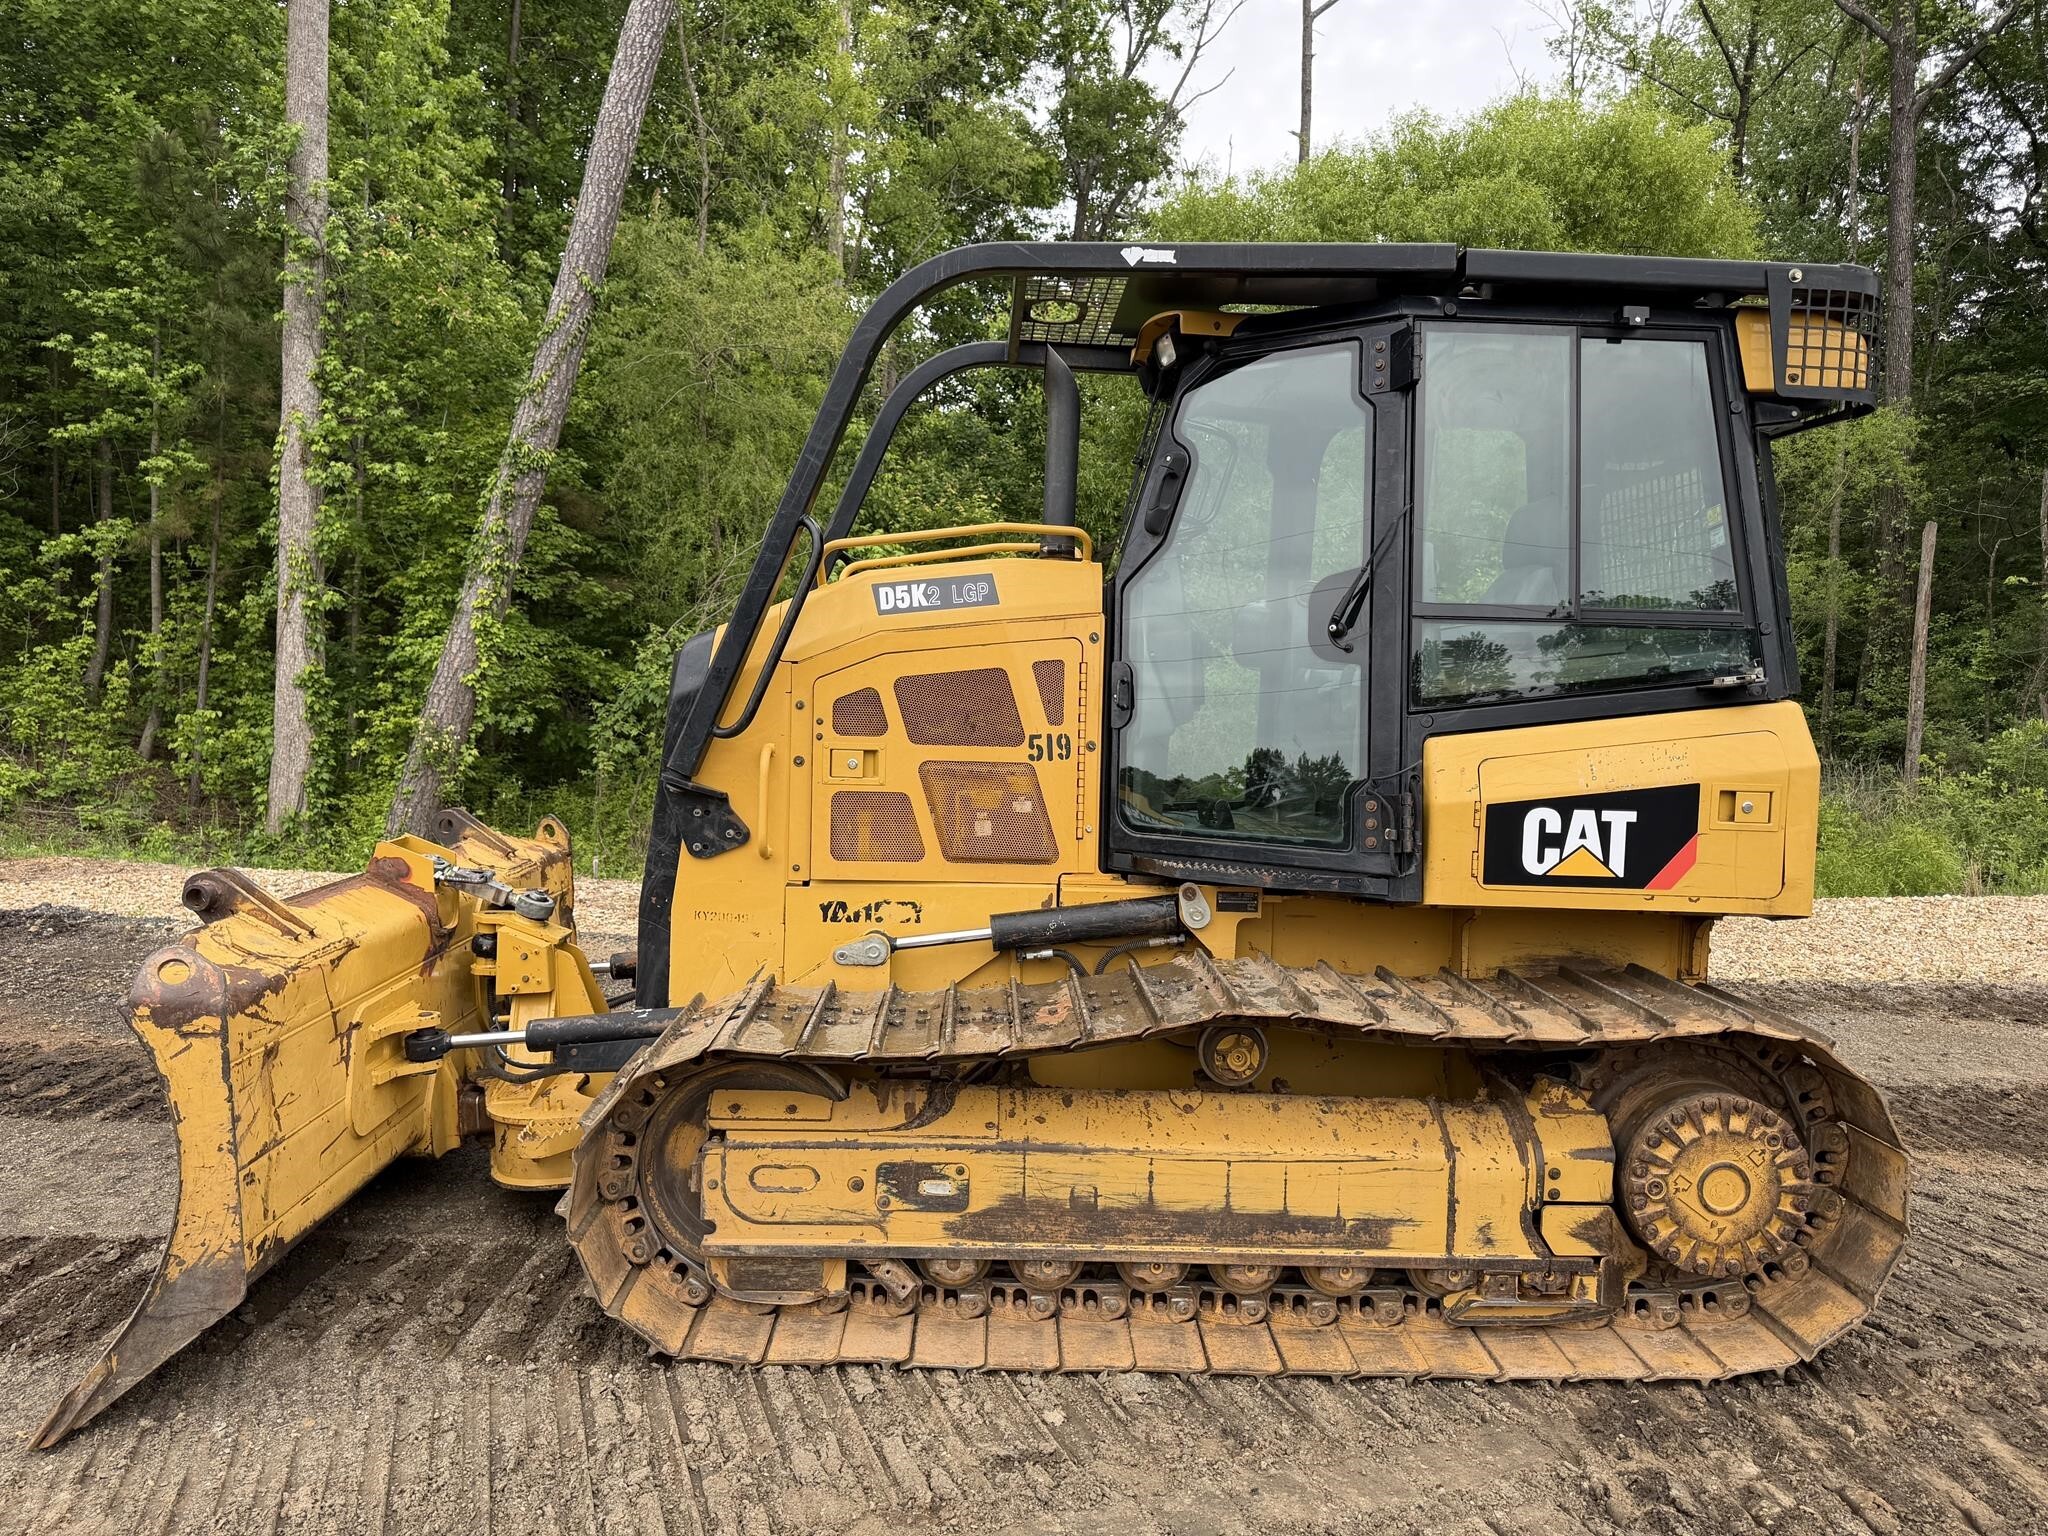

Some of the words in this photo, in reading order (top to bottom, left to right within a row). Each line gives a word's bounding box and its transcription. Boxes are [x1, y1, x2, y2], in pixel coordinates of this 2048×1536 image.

[878, 583, 941, 611] D5K2
[951, 582, 990, 604] LGP
[1027, 733, 1072, 762] 519
[1521, 806, 1638, 878] CAT
